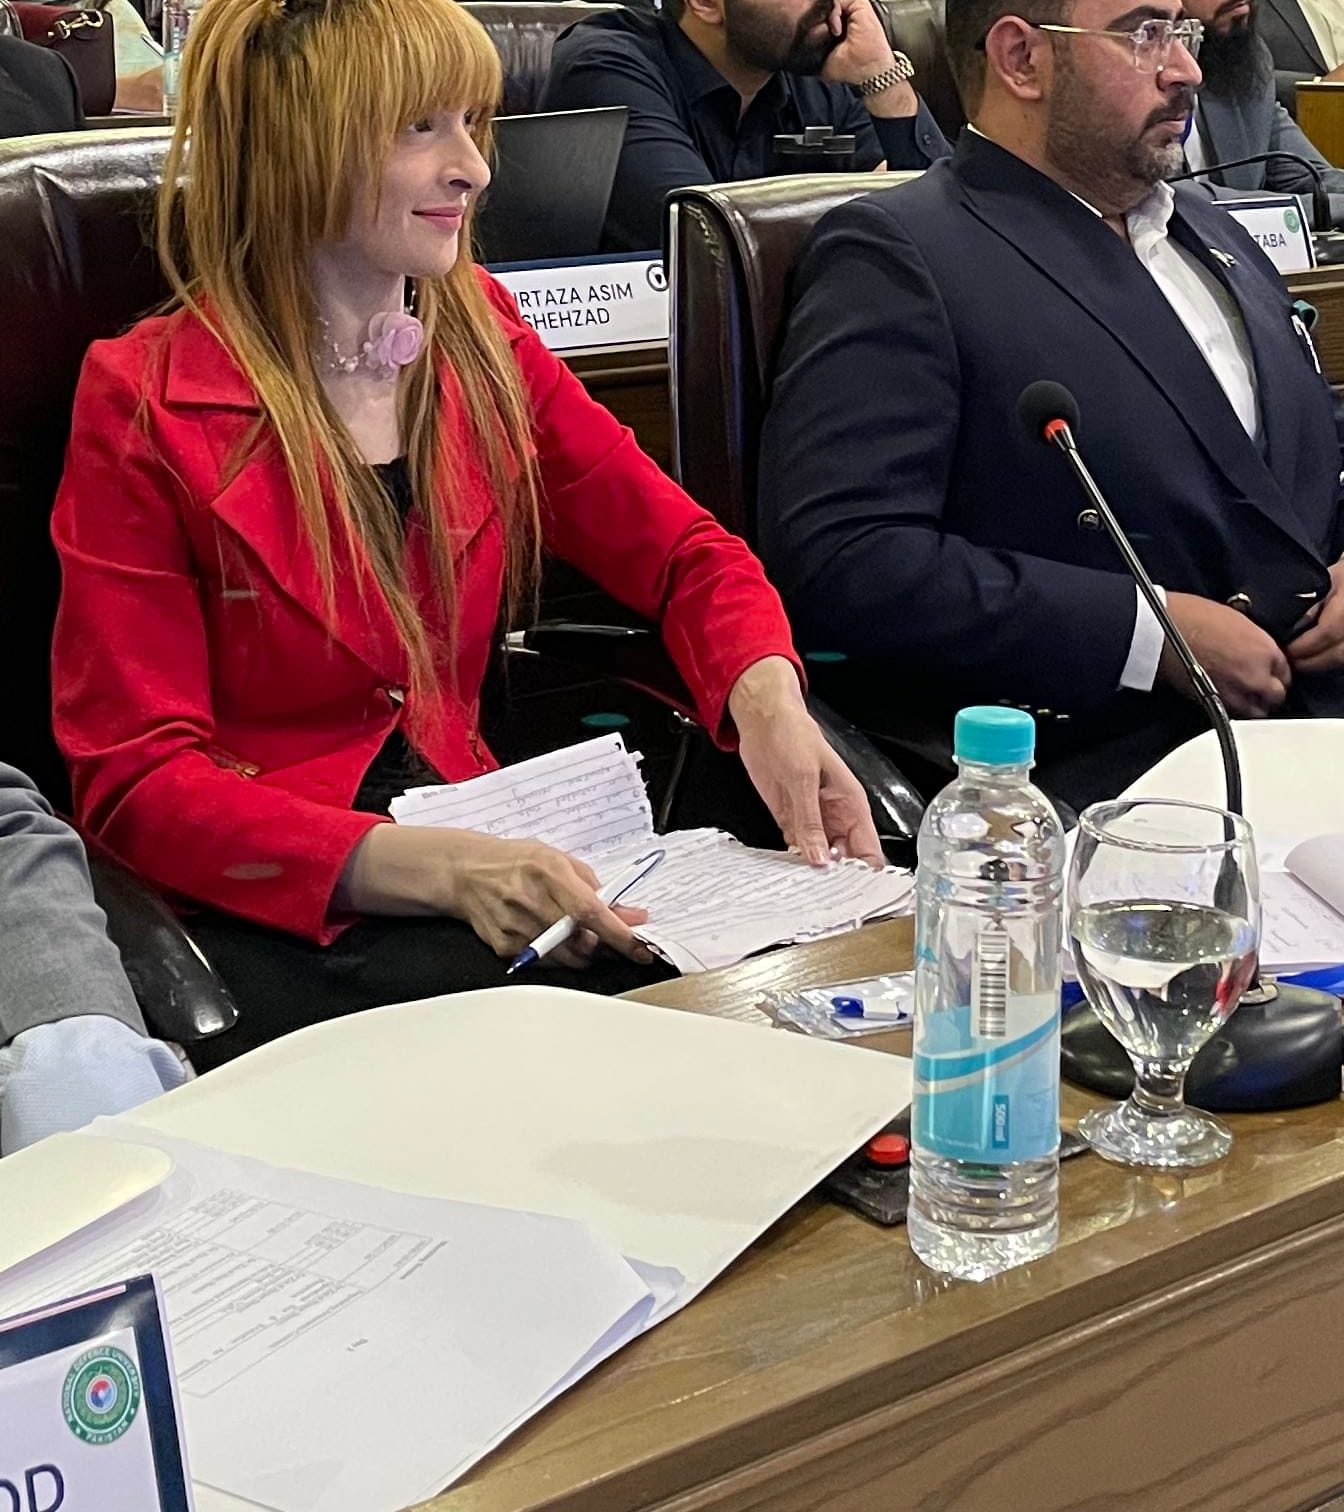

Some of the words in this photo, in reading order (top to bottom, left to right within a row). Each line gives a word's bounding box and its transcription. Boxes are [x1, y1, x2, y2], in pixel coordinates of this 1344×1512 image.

[1253, 232, 1287, 248] TABA
[588, 282, 633, 303] ASIM
[521, 307, 611, 330] SHEHZAD
